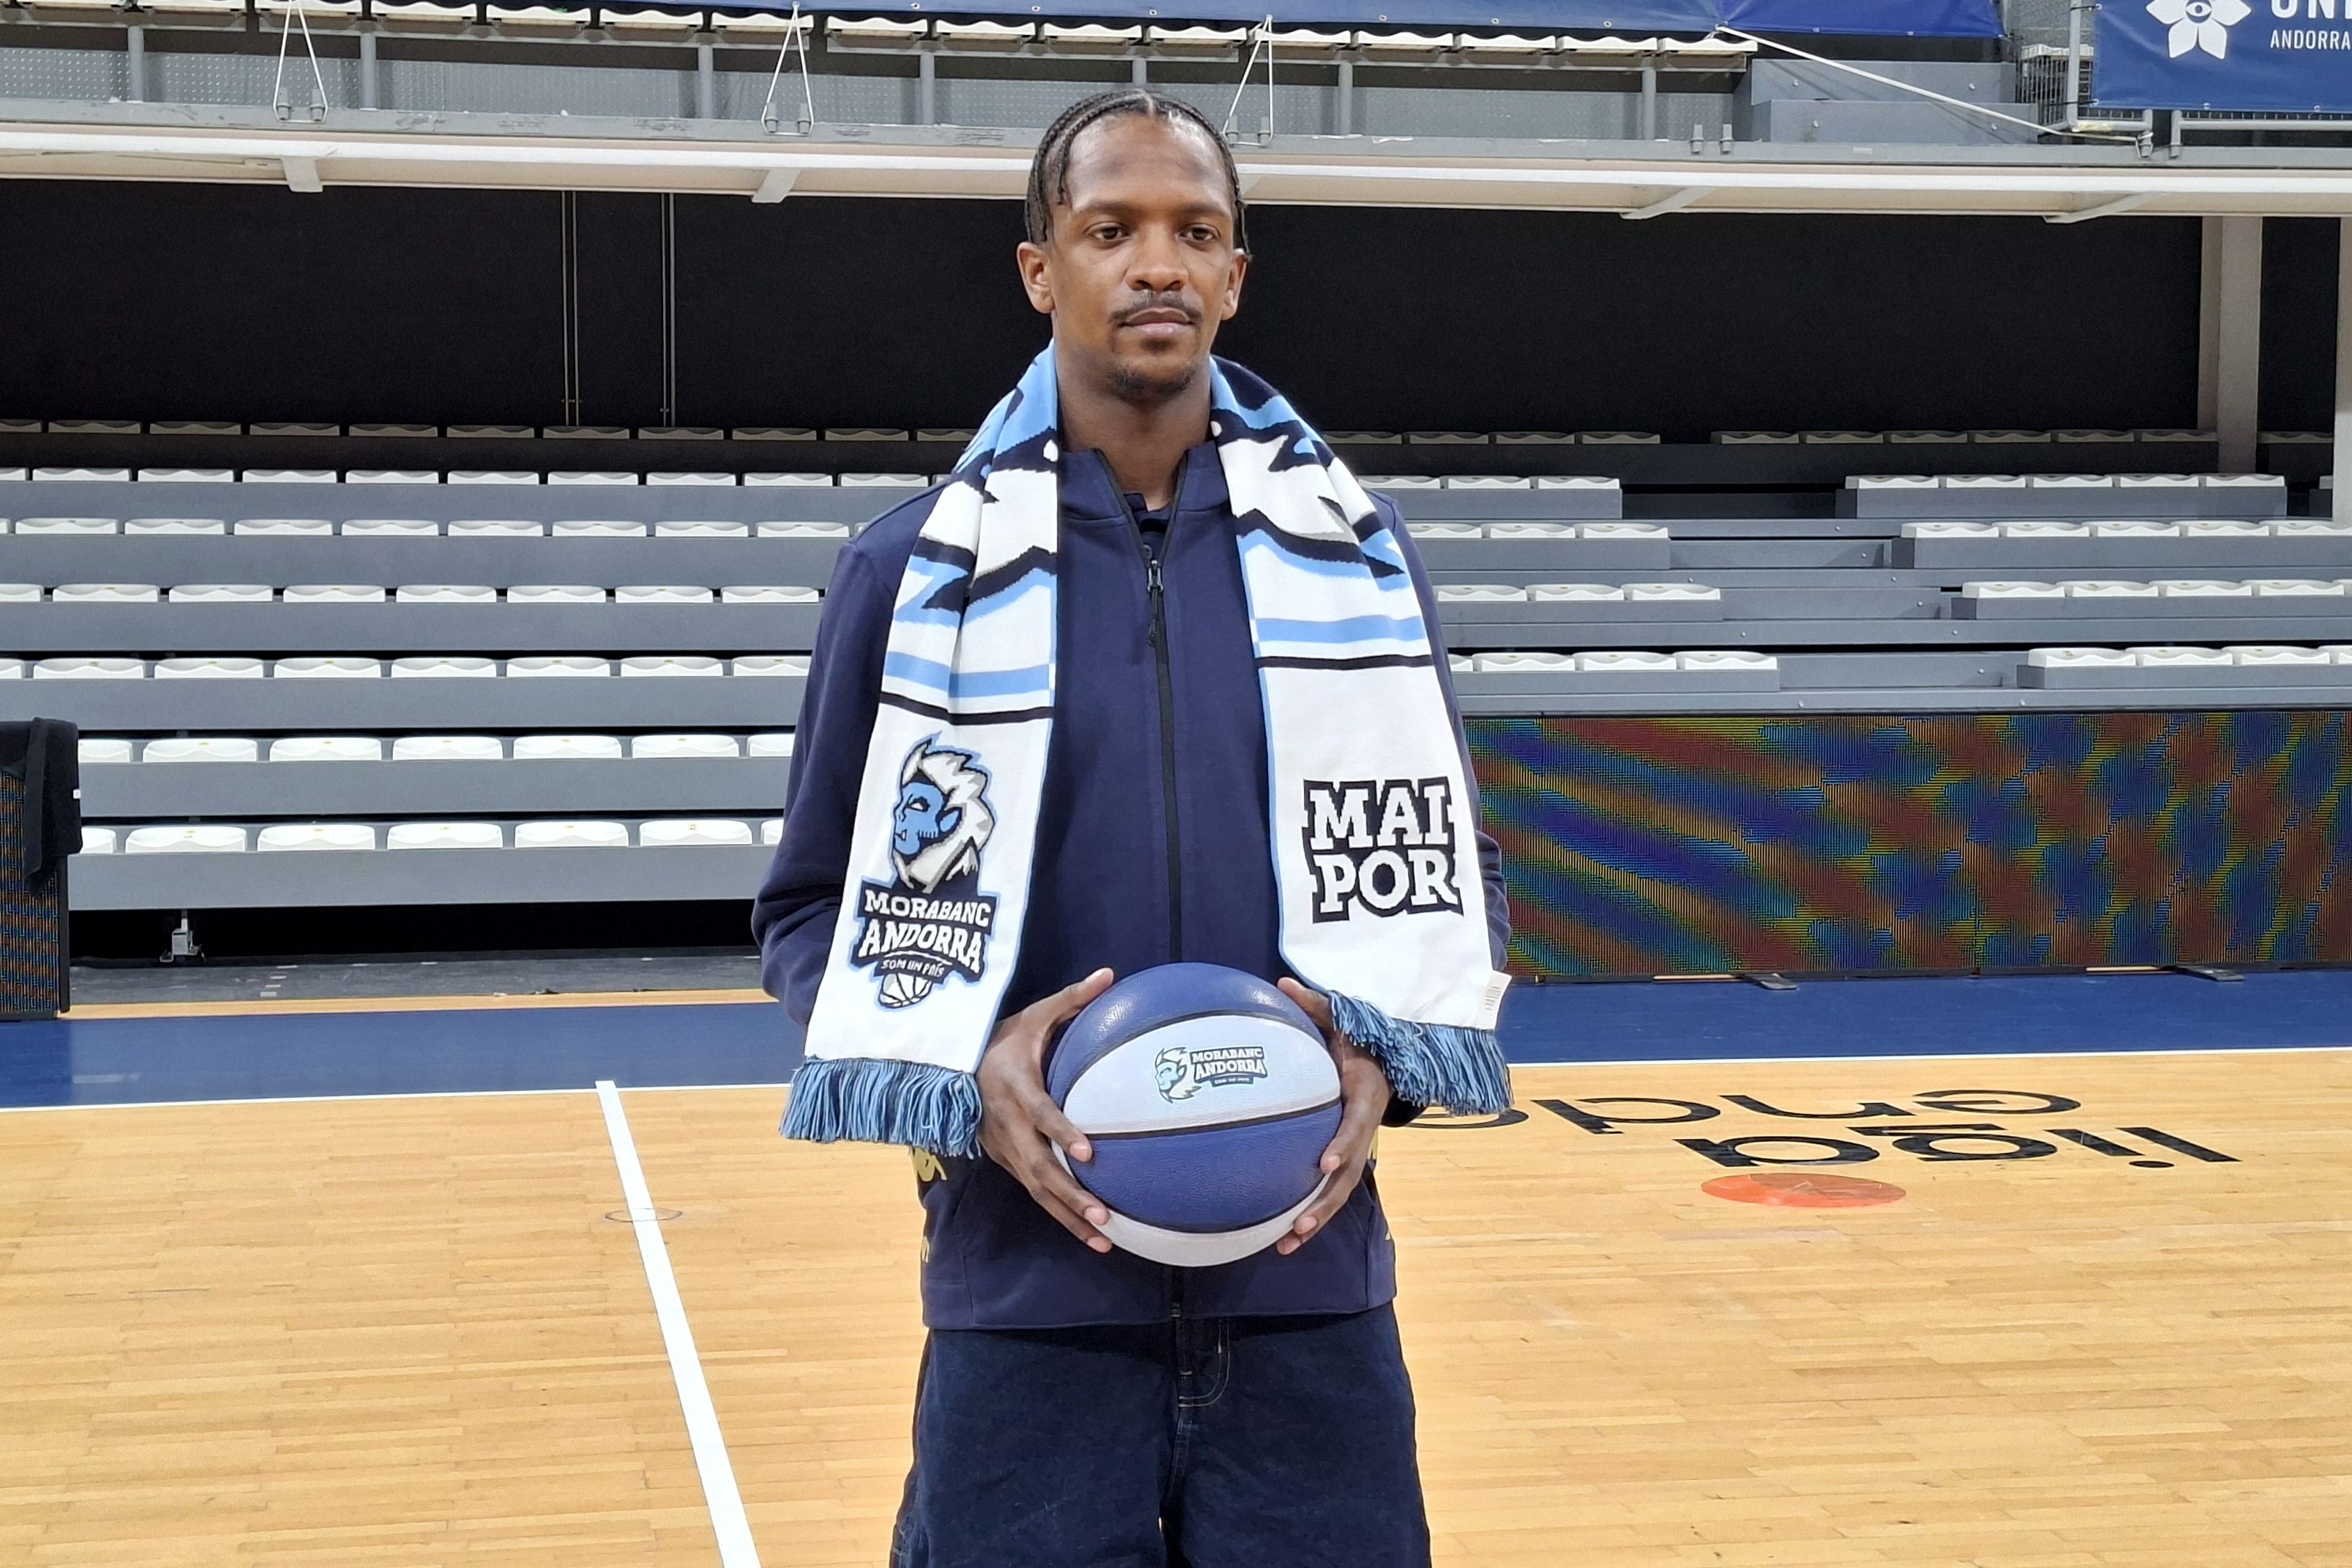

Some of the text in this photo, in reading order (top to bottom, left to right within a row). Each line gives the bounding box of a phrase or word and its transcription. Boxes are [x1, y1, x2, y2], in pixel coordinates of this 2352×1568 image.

[2270, 29, 2351, 50] ANDORRA
[1306, 781, 1451, 851] MAI
[1311, 849, 1460, 916] POR
[865, 888, 991, 927] MORABANC
[858, 918, 982, 974] ANDORRA
[881, 959, 907, 970] SOM
[907, 960, 923, 972] UN
[1195, 1058, 1266, 1081] ANDORRA
[1401, 1089, 2082, 1135] ende
[1674, 1122, 2241, 1168] liga
